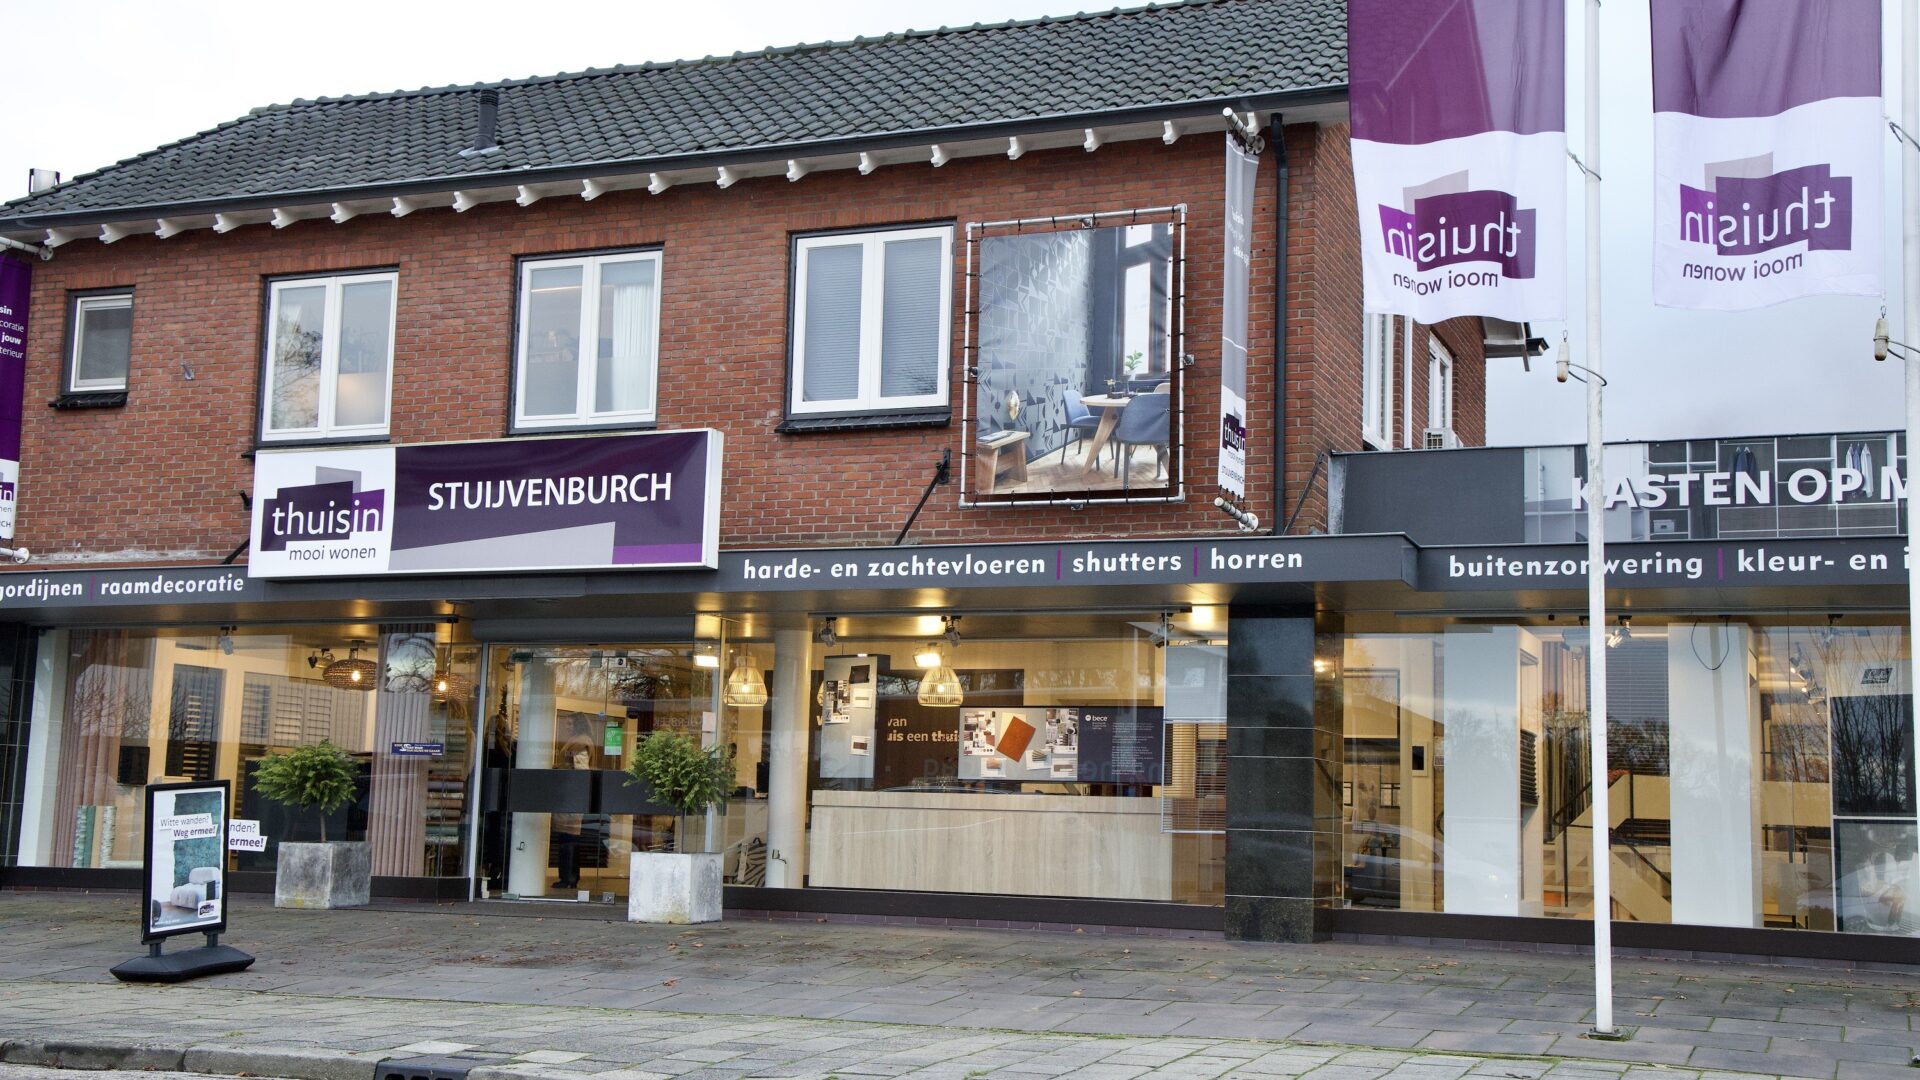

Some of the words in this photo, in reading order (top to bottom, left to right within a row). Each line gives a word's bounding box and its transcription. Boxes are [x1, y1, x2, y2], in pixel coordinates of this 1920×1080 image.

[1, 332, 22, 345] jouw
[428, 472, 672, 511] STUIJVENBURCH
[1572, 470, 1770, 510] KASTEN
[1788, 467, 1863, 503] OP
[272, 499, 380, 536] thuisin
[289, 545, 325, 561] mooi
[329, 547, 376, 560] wonen
[1072, 551, 1182, 573] shutters
[1211, 547, 1303, 570] horren
[1738, 548, 1834, 572] kleur-
[1849, 553, 1888, 570] en
[743, 558, 821, 579] harde-
[830, 560, 858, 577] en
[867, 553, 1046, 577] zachtevloeren
[101, 573, 244, 595] raamdecoratie
[906, 732, 929, 742] een
[931, 730, 960, 742] thui
[161, 818, 179, 827] Witte
[180, 815, 209, 825] wanden?
[173, 829, 189, 838] Weg
[190, 825, 216, 836] ermee!
[229, 837, 264, 848] ermee!
